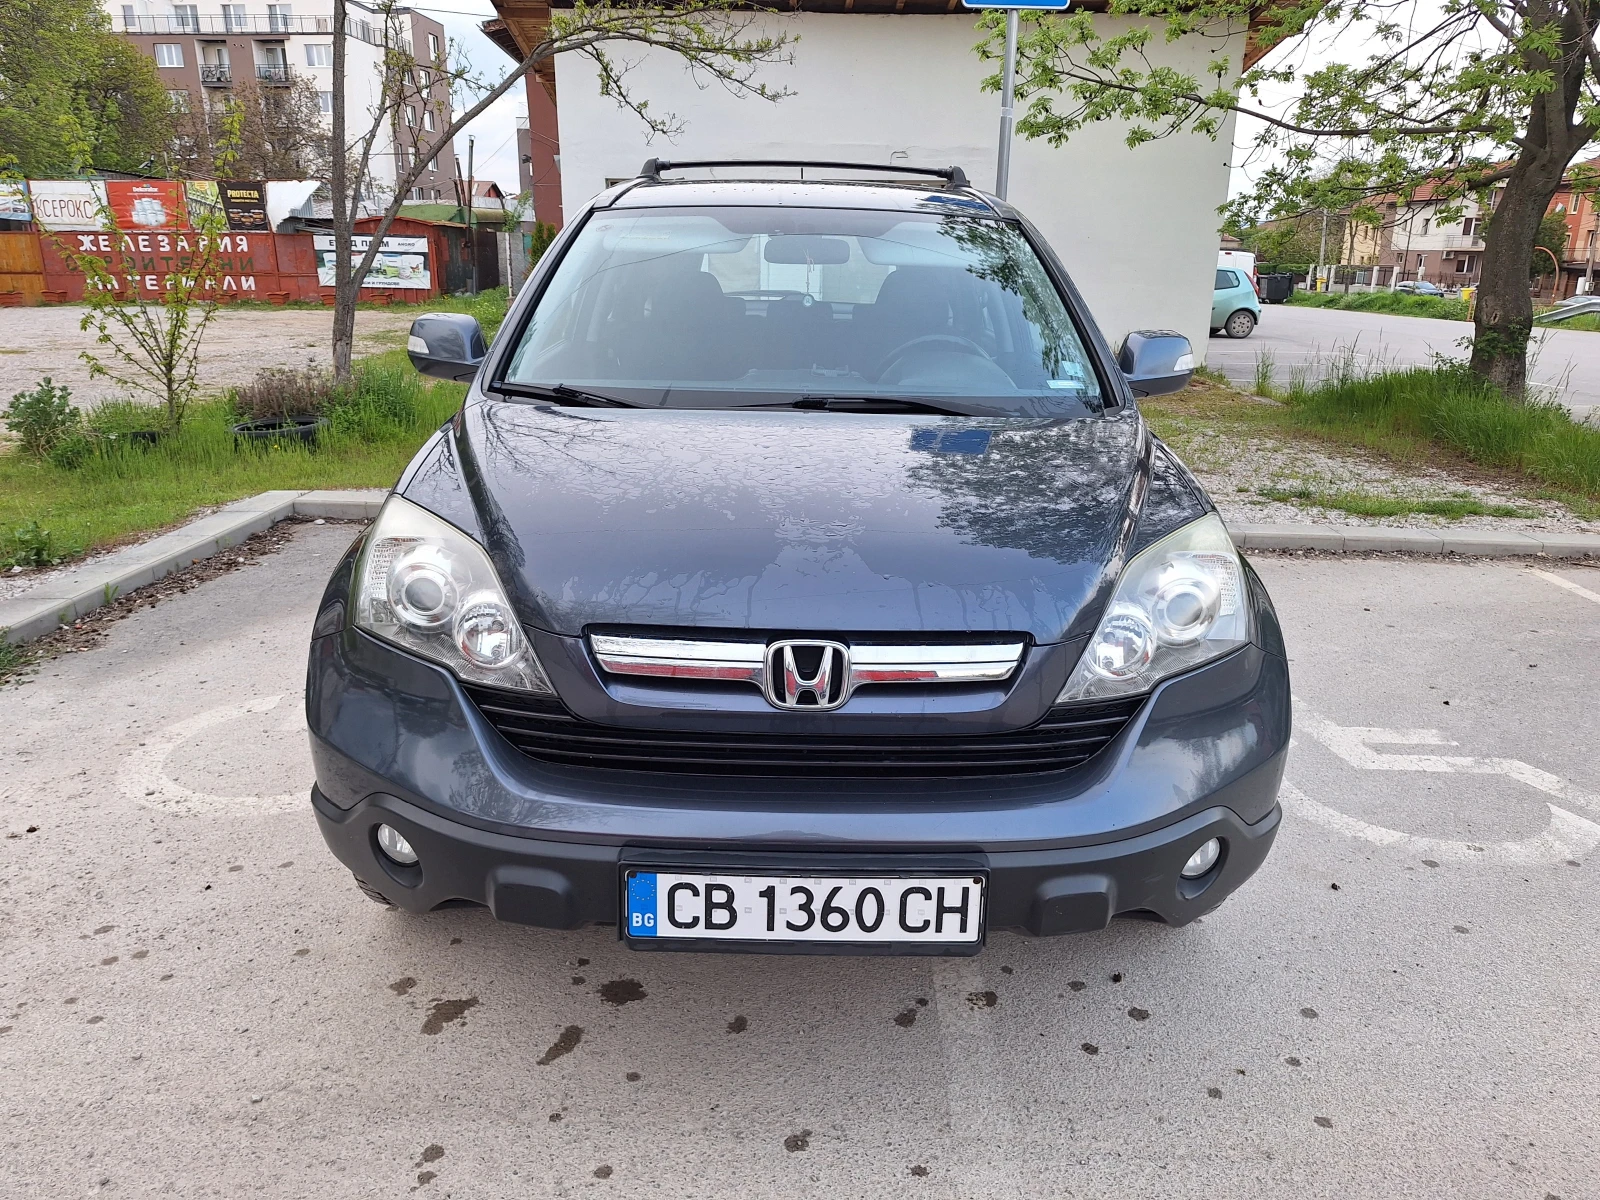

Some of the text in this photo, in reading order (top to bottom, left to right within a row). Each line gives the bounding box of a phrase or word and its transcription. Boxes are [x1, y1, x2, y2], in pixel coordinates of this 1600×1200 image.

[226, 189, 260, 199] PROTECTA
[35, 199, 93, 220] КСЕРОКС
[77, 234, 248, 253] ЖЕЛЕЗАРИЯ
[65, 255, 255, 272] СРОИТЕНИ
[667, 881, 970, 934] CB 1360 CH
[632, 912, 655, 927] BG
